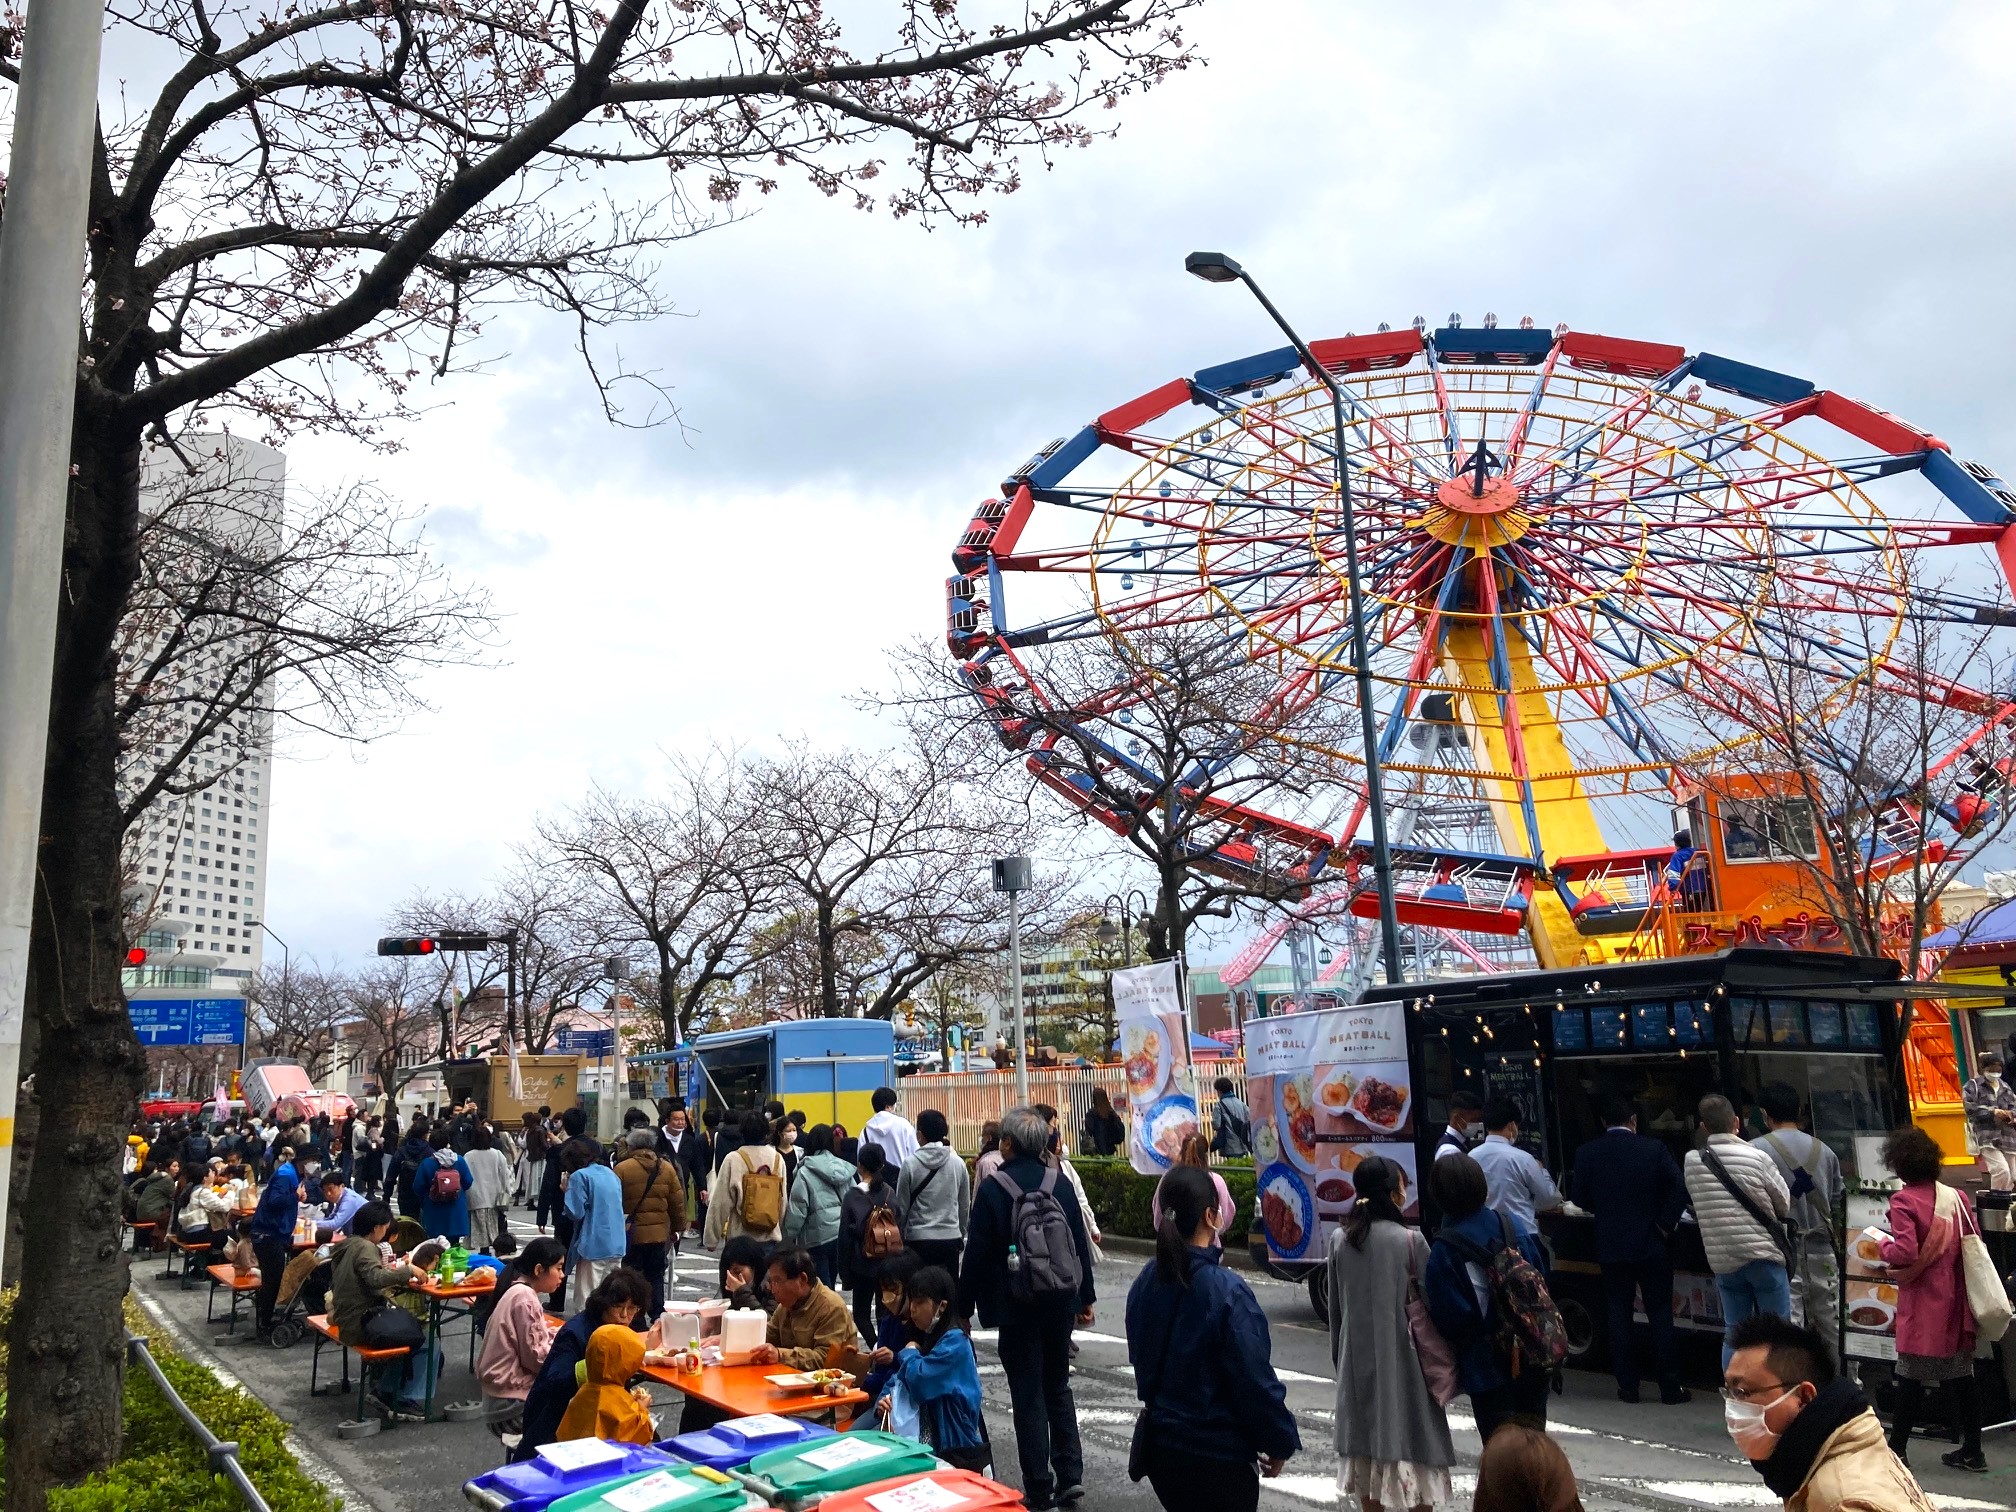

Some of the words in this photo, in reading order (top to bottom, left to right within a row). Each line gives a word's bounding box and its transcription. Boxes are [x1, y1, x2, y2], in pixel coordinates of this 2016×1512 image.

[1686, 912, 1917, 946] スーパープラット
[1349, 1017, 1374, 1027] TOKYO
[1270, 1028, 1293, 1036] TOKYO
